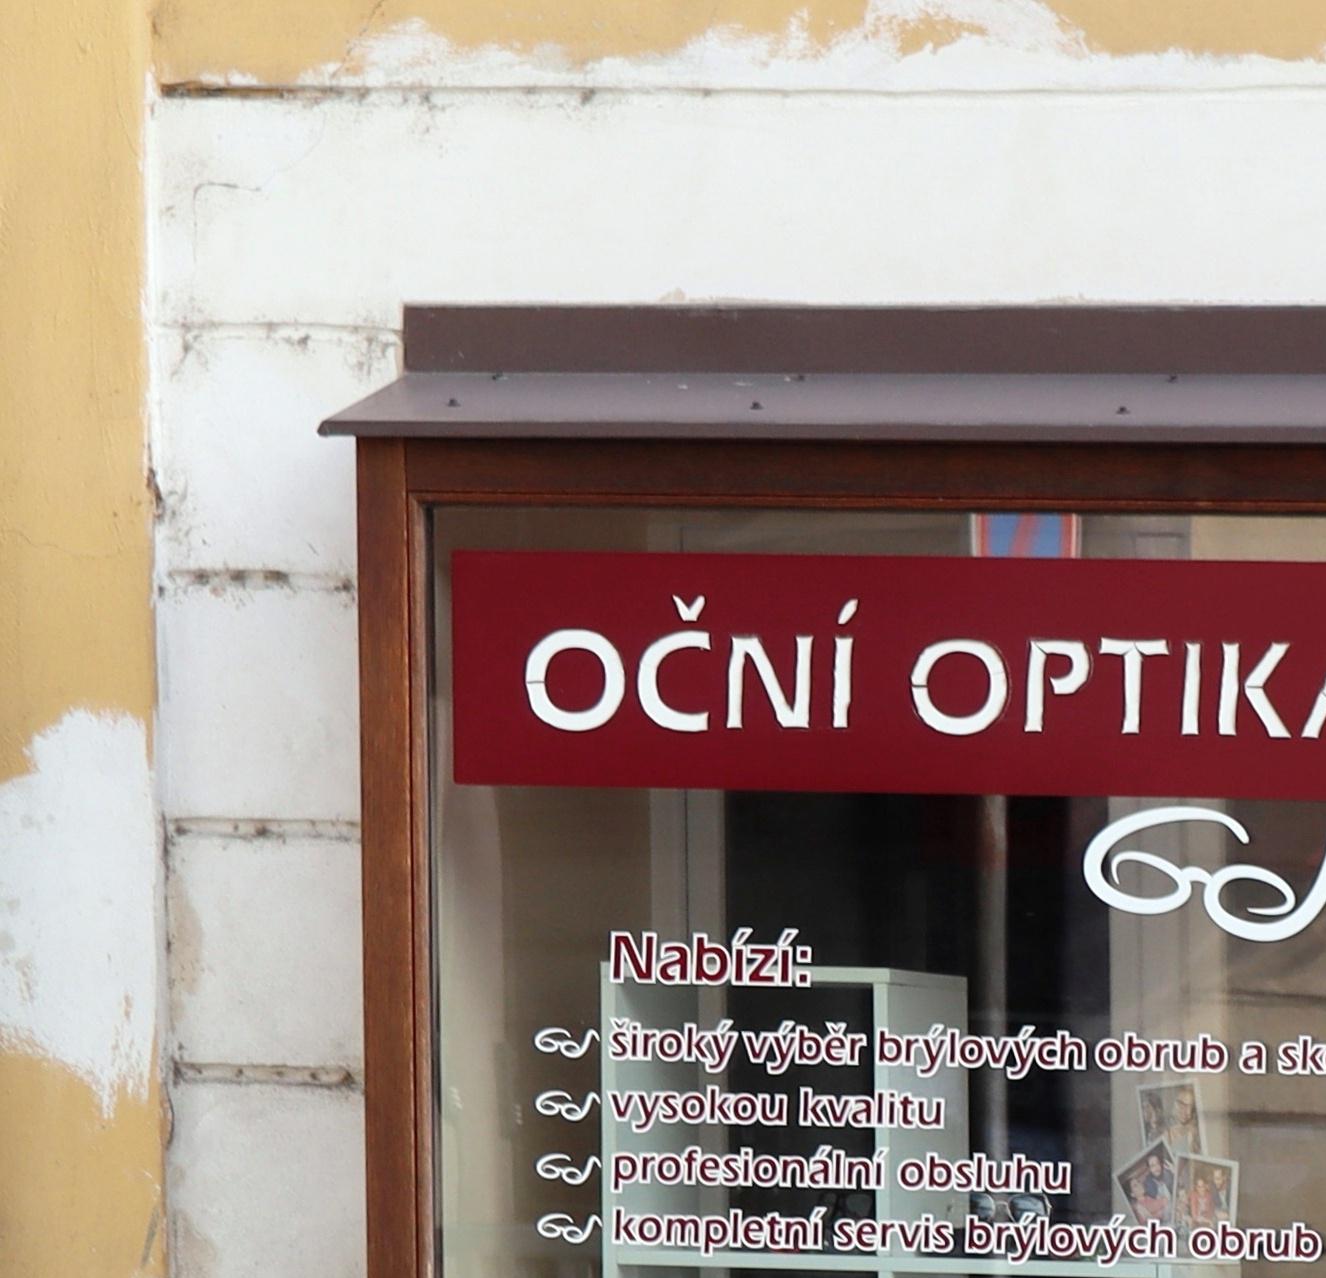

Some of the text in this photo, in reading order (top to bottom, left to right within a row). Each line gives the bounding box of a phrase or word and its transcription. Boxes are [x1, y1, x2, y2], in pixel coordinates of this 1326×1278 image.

[526, 596, 858, 731] OČNÍ
[609, 927, 813, 988] Nabízí:
[609, 1017, 738, 1073] široký
[742, 1021, 867, 1075] výběr
[877, 1023, 1087, 1080] brýlových
[1096, 1031, 1229, 1073] obrub
[1239, 1041, 1267, 1073] a
[608, 1085, 945, 1134] vysokou kvalitu
[610, 1145, 1073, 1195] profesionální obsluhu
[612, 1207, 1323, 1267] kompletní servis brýlových obrub
